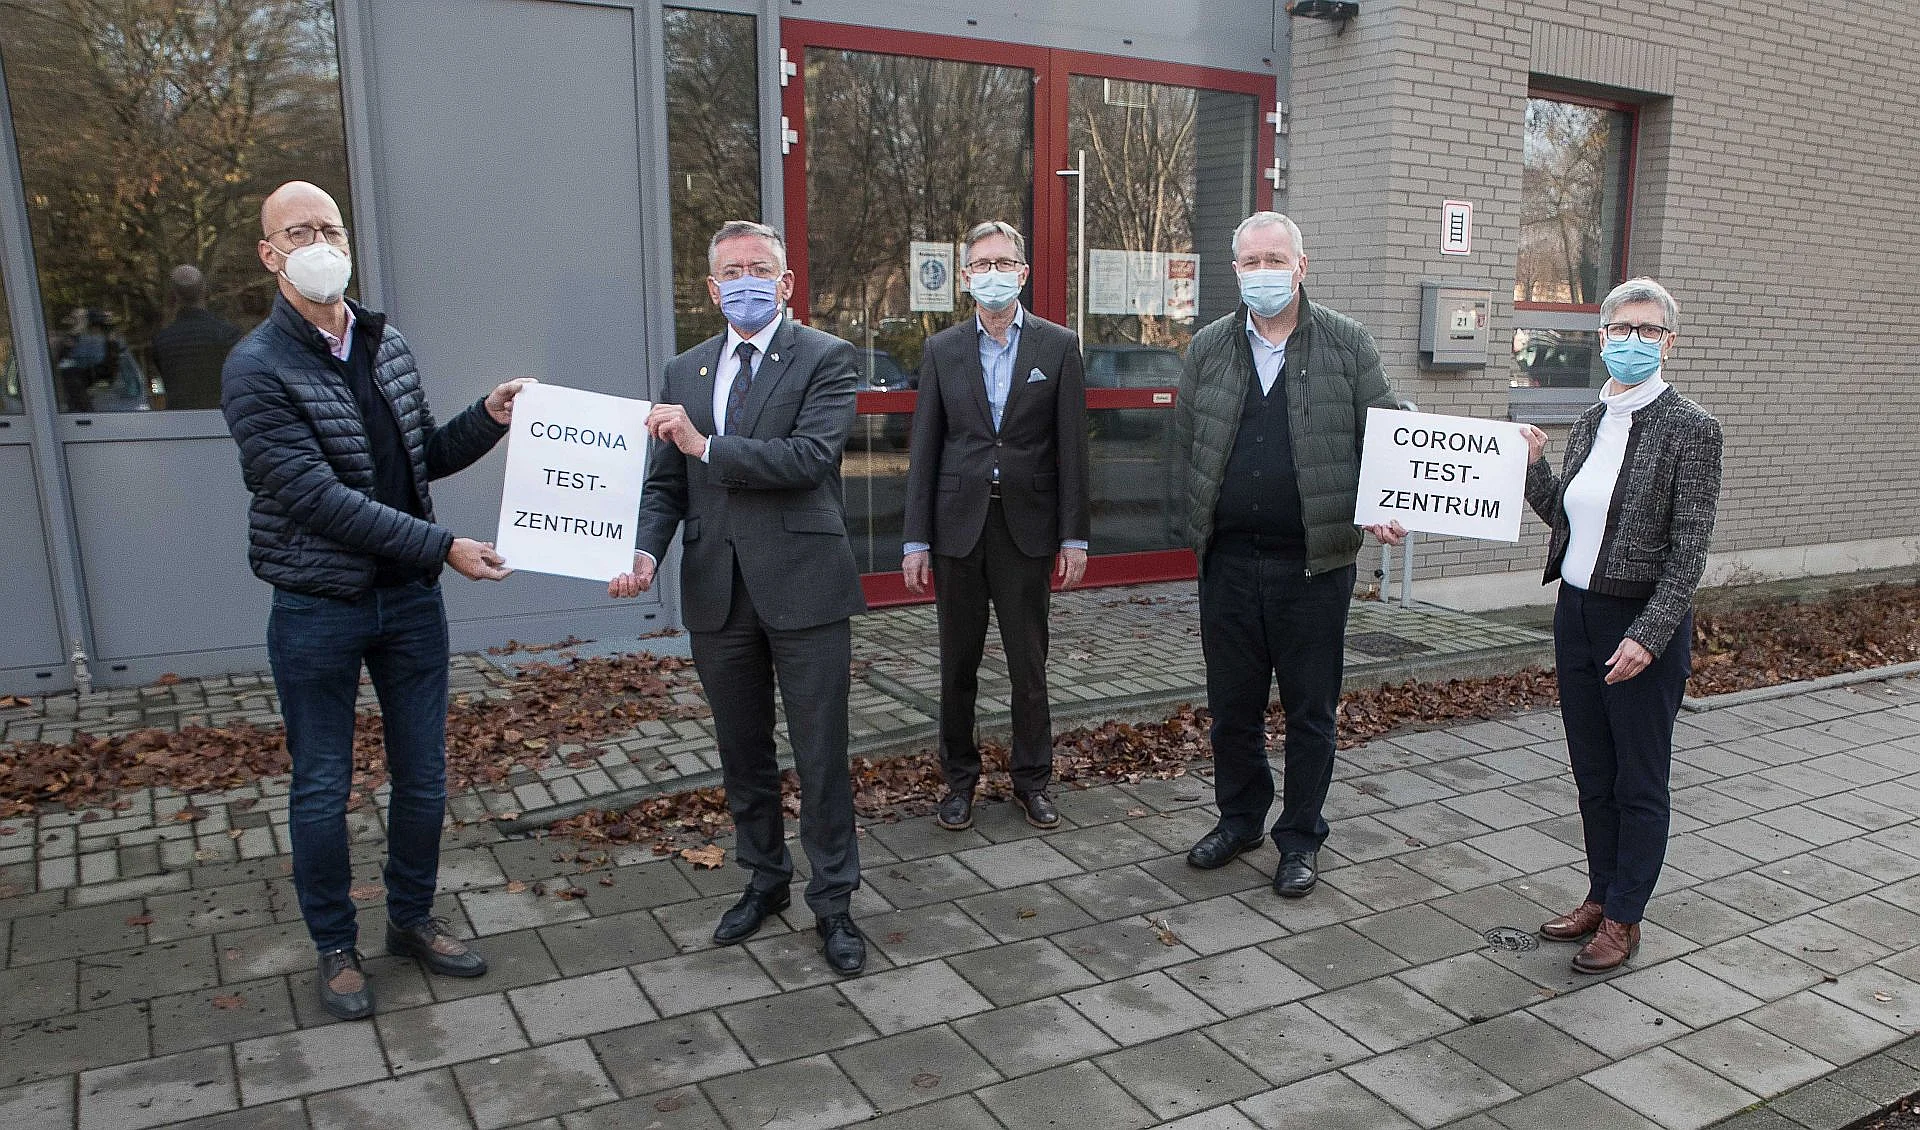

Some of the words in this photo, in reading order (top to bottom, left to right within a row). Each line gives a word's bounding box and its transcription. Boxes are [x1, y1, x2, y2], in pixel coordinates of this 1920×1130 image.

[1457, 317, 1467, 326] 21
[531, 421, 627, 451] CORONA
[1393, 427, 1501, 455] CORONA
[543, 468, 607, 491] TEST-
[1409, 459, 1480, 483] TEST-
[1378, 489, 1500, 519] ZENTRUM
[514, 510, 623, 540] ZENTRUM
